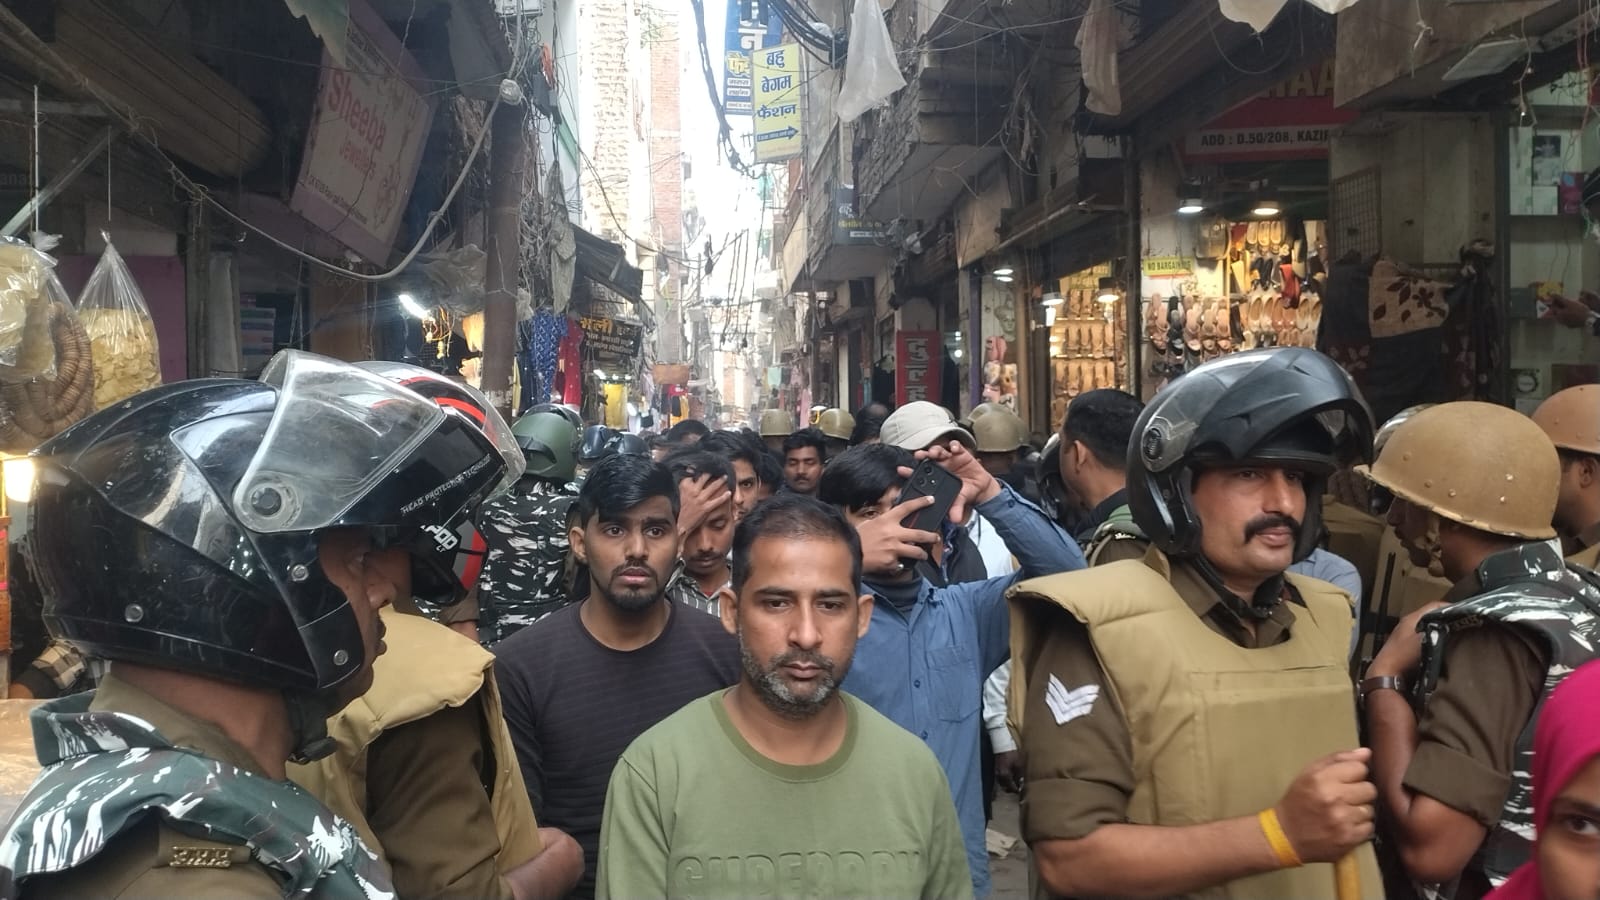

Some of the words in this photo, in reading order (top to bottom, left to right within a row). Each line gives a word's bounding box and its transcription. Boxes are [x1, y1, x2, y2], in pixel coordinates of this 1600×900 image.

[766, 50, 785, 67] बहु
[761, 75, 792, 93] बेगम
[328, 70, 387, 152] Sheeba
[1201, 134, 1225, 146] ADD
[1147, 262, 1156, 271] NO
[400, 497, 424, 514] HEAD
[425, 474, 465, 502] PROTECTION
